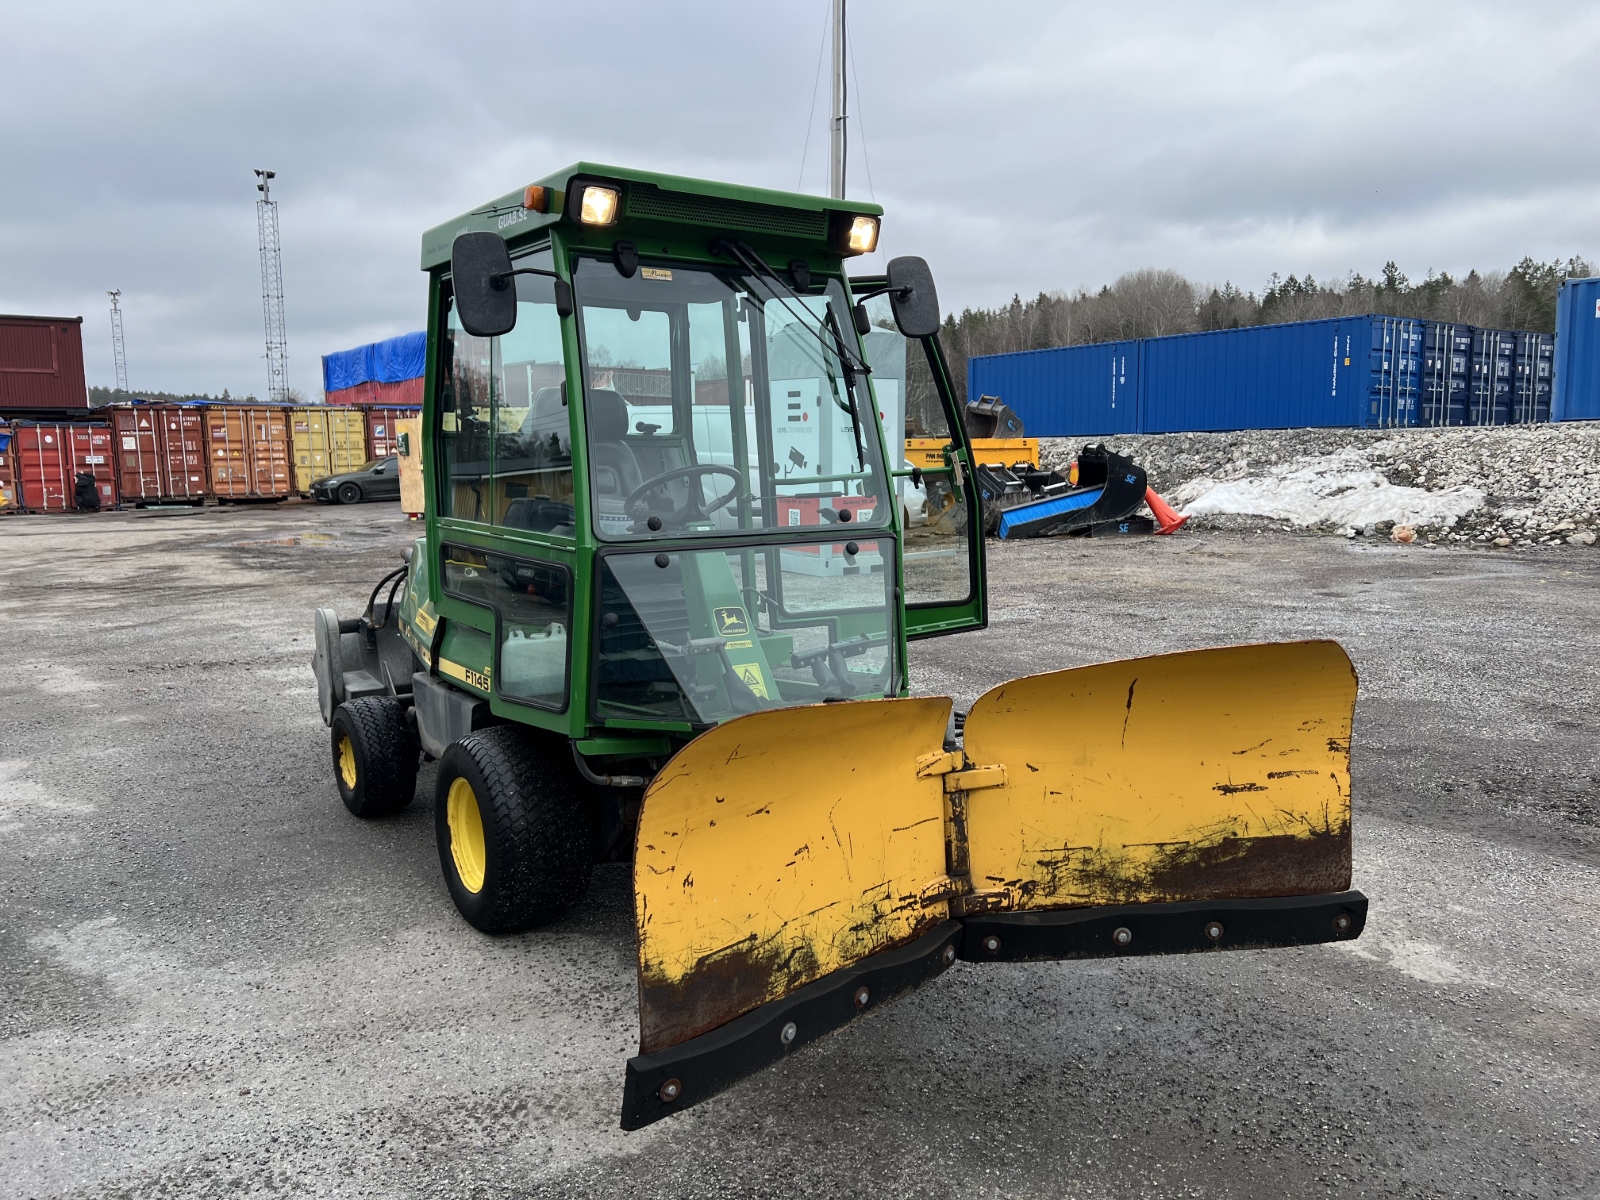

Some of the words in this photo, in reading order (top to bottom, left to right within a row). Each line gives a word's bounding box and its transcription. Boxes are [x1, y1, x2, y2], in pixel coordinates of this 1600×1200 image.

[498, 208, 528, 229] GUAB.SE
[1125, 474, 1137, 485] SE
[1118, 522, 1130, 533] SE
[465, 668, 490, 692] F1145
